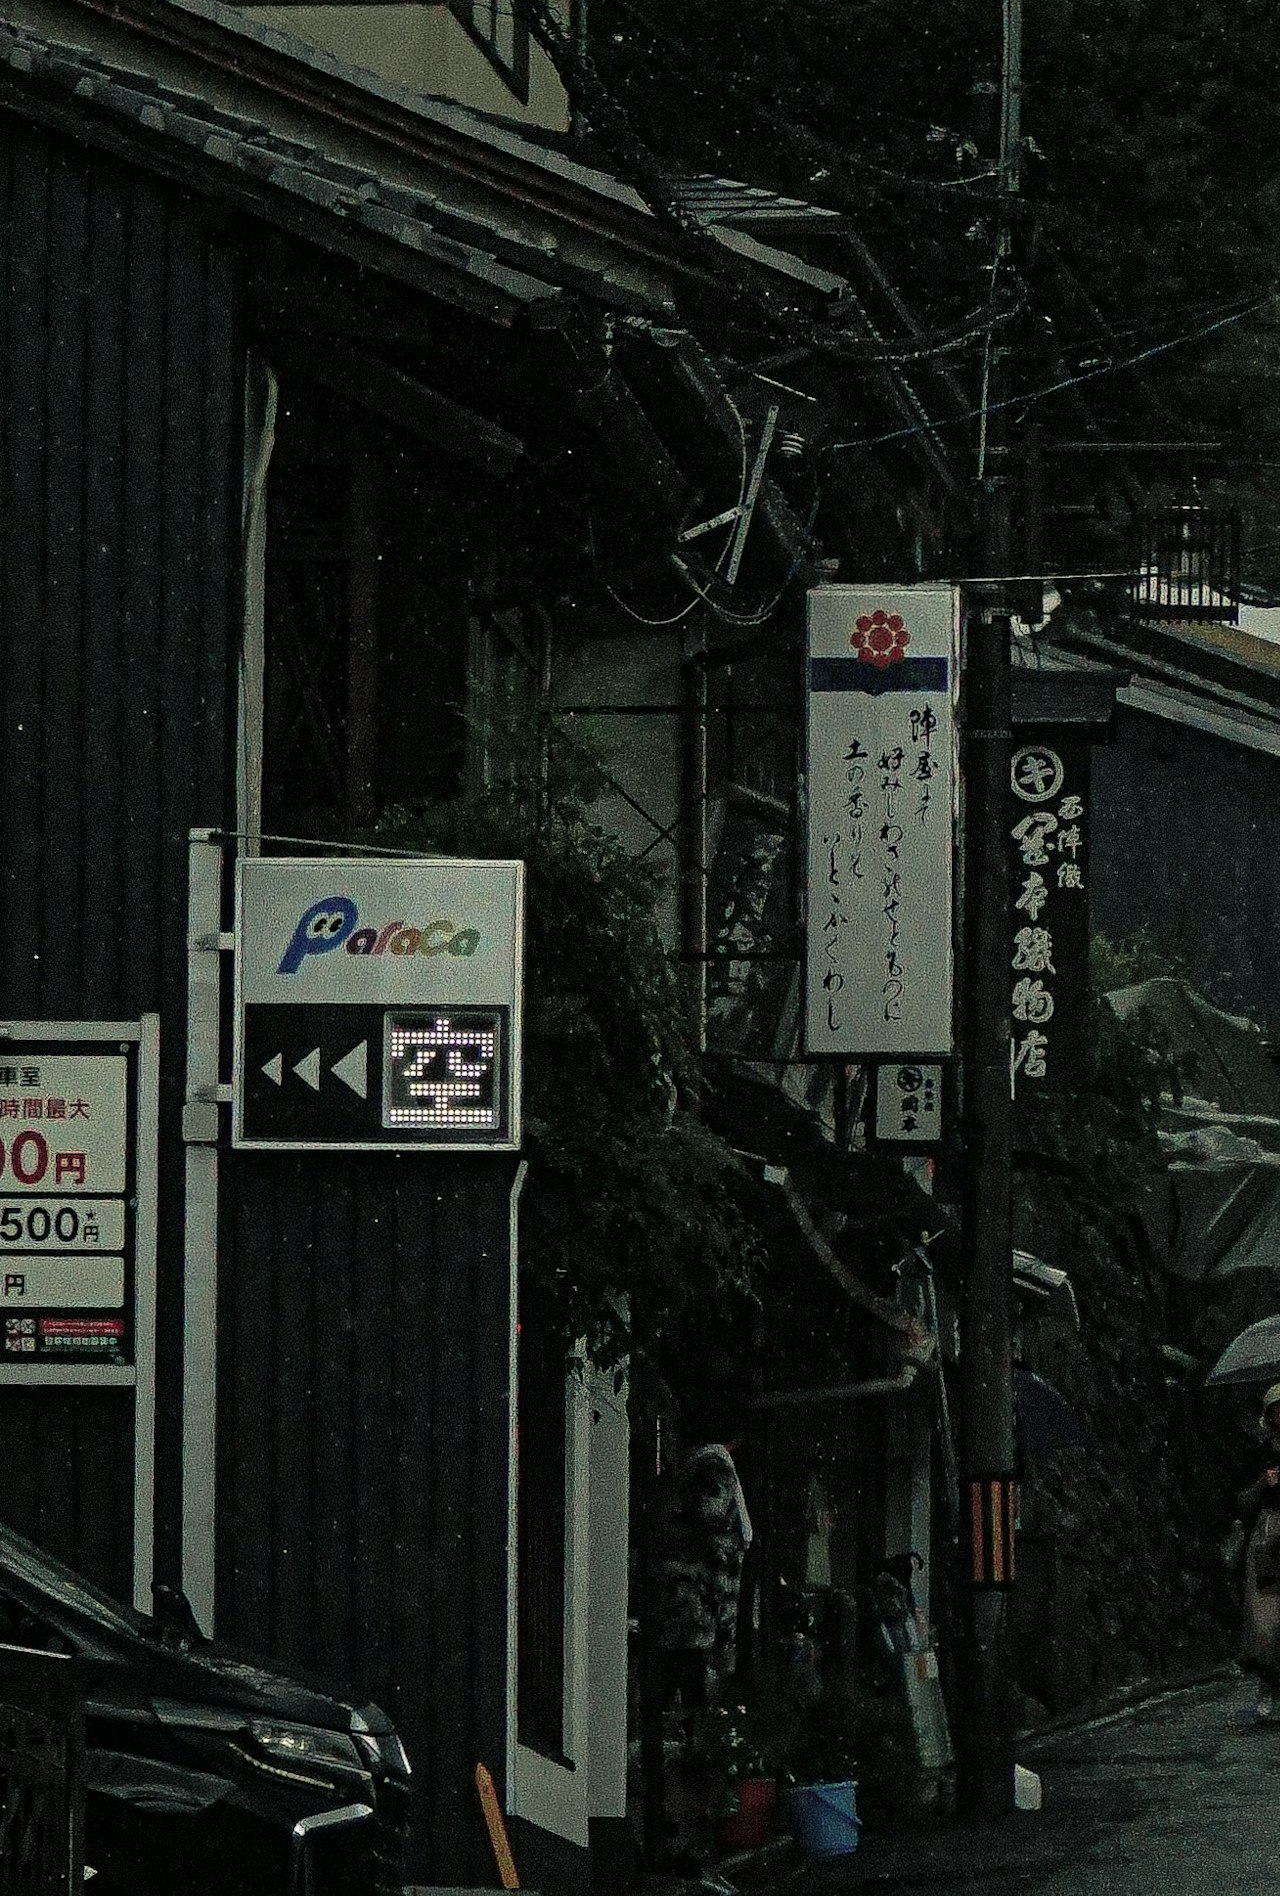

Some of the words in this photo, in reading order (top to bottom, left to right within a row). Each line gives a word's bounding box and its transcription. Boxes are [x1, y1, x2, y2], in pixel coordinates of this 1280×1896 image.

[274, 895, 482, 975] Paraca
[390, 1019, 495, 1123] 空
[4, 1274, 25, 1296] 円
